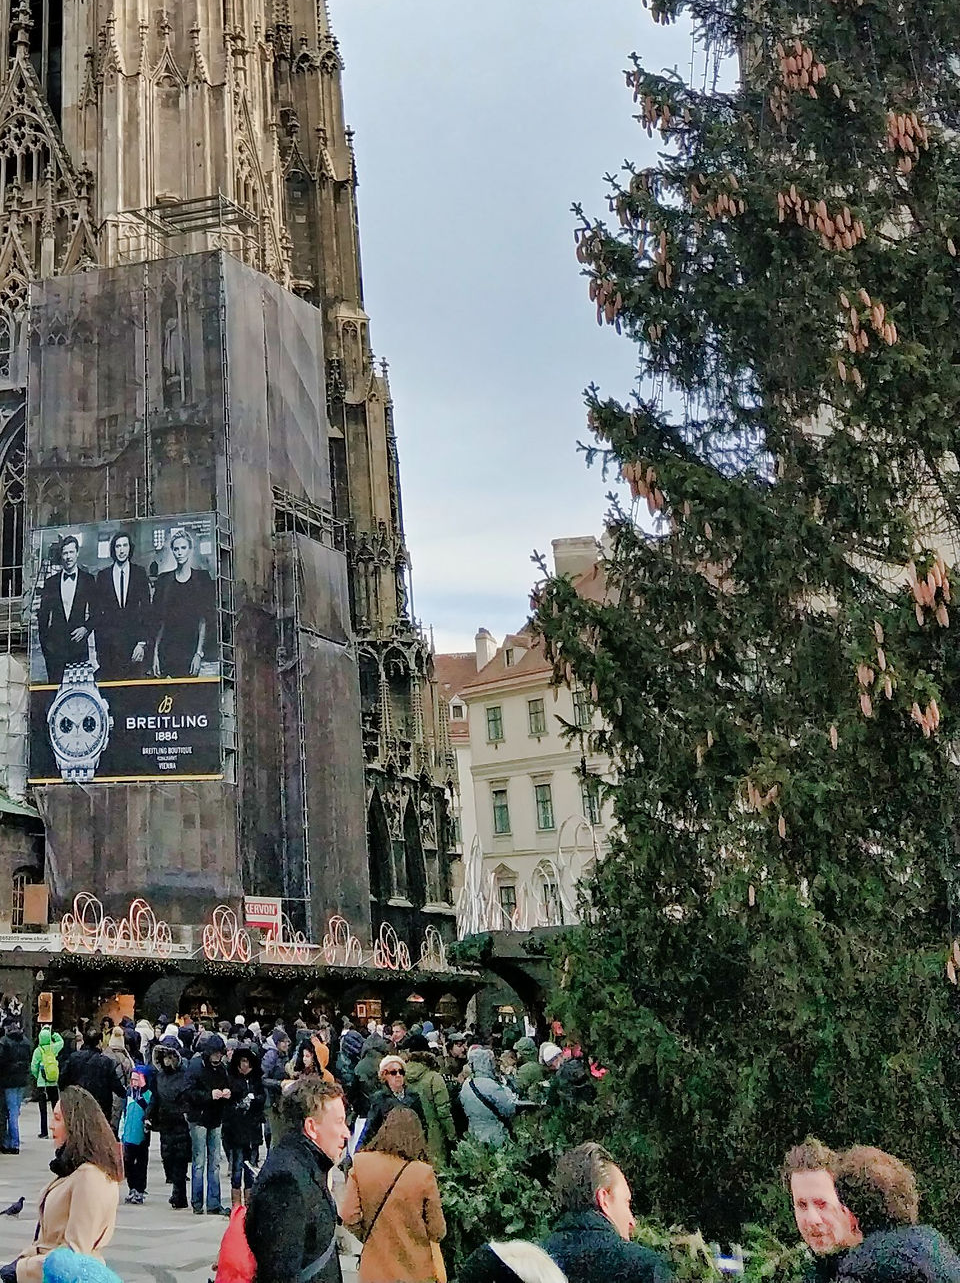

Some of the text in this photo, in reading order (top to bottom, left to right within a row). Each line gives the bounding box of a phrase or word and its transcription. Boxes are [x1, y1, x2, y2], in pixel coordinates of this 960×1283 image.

[126, 715, 208, 730] BREITLING
[155, 731, 178, 742] 1884
[142, 746, 192, 755] BREITLING BOUTIQUE
